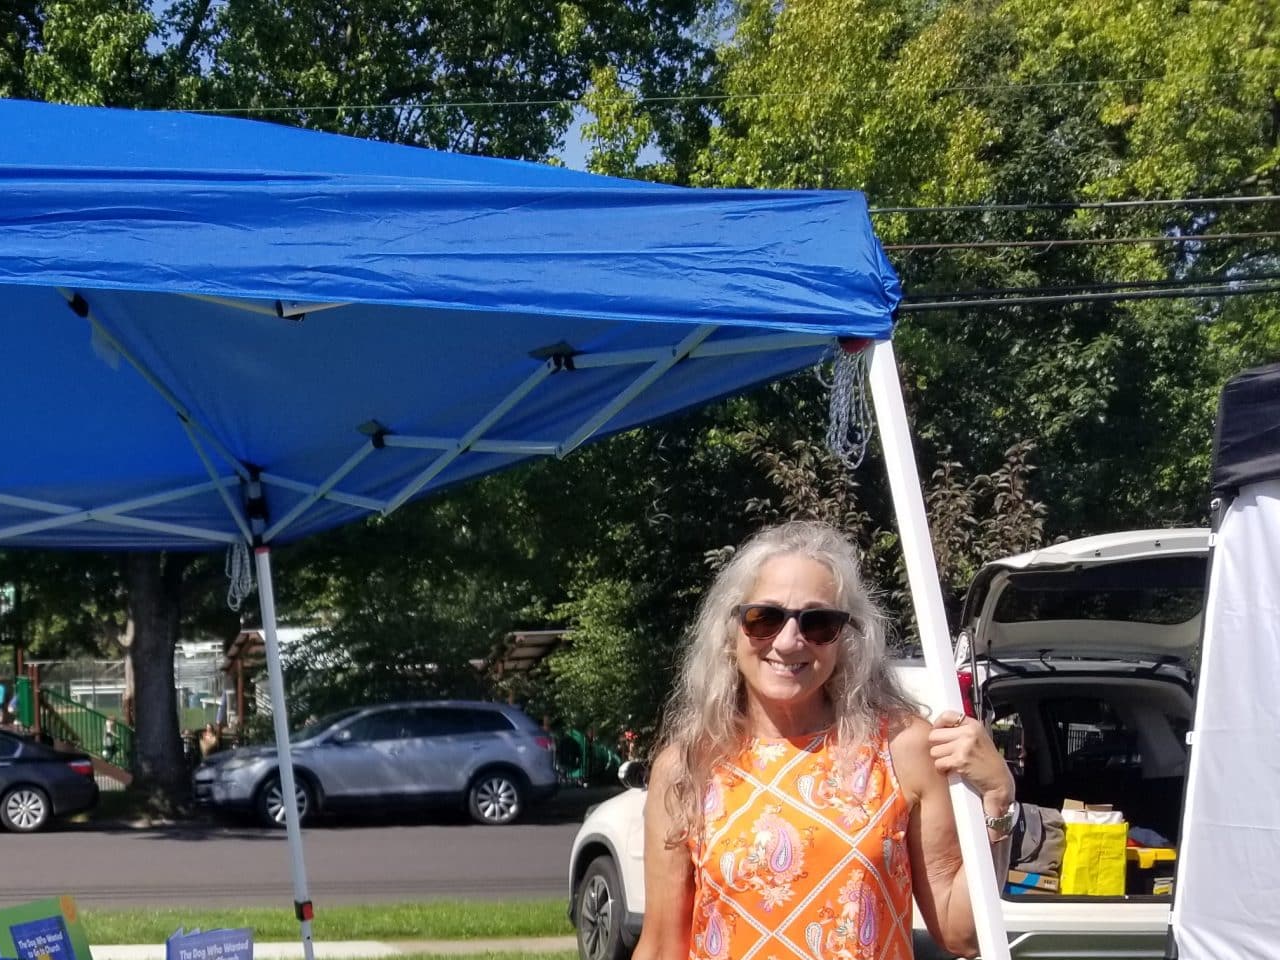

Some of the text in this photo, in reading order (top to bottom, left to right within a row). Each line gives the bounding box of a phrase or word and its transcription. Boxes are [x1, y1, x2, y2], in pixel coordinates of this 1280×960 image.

[179, 938, 249, 960] The Dog Who Wanted
